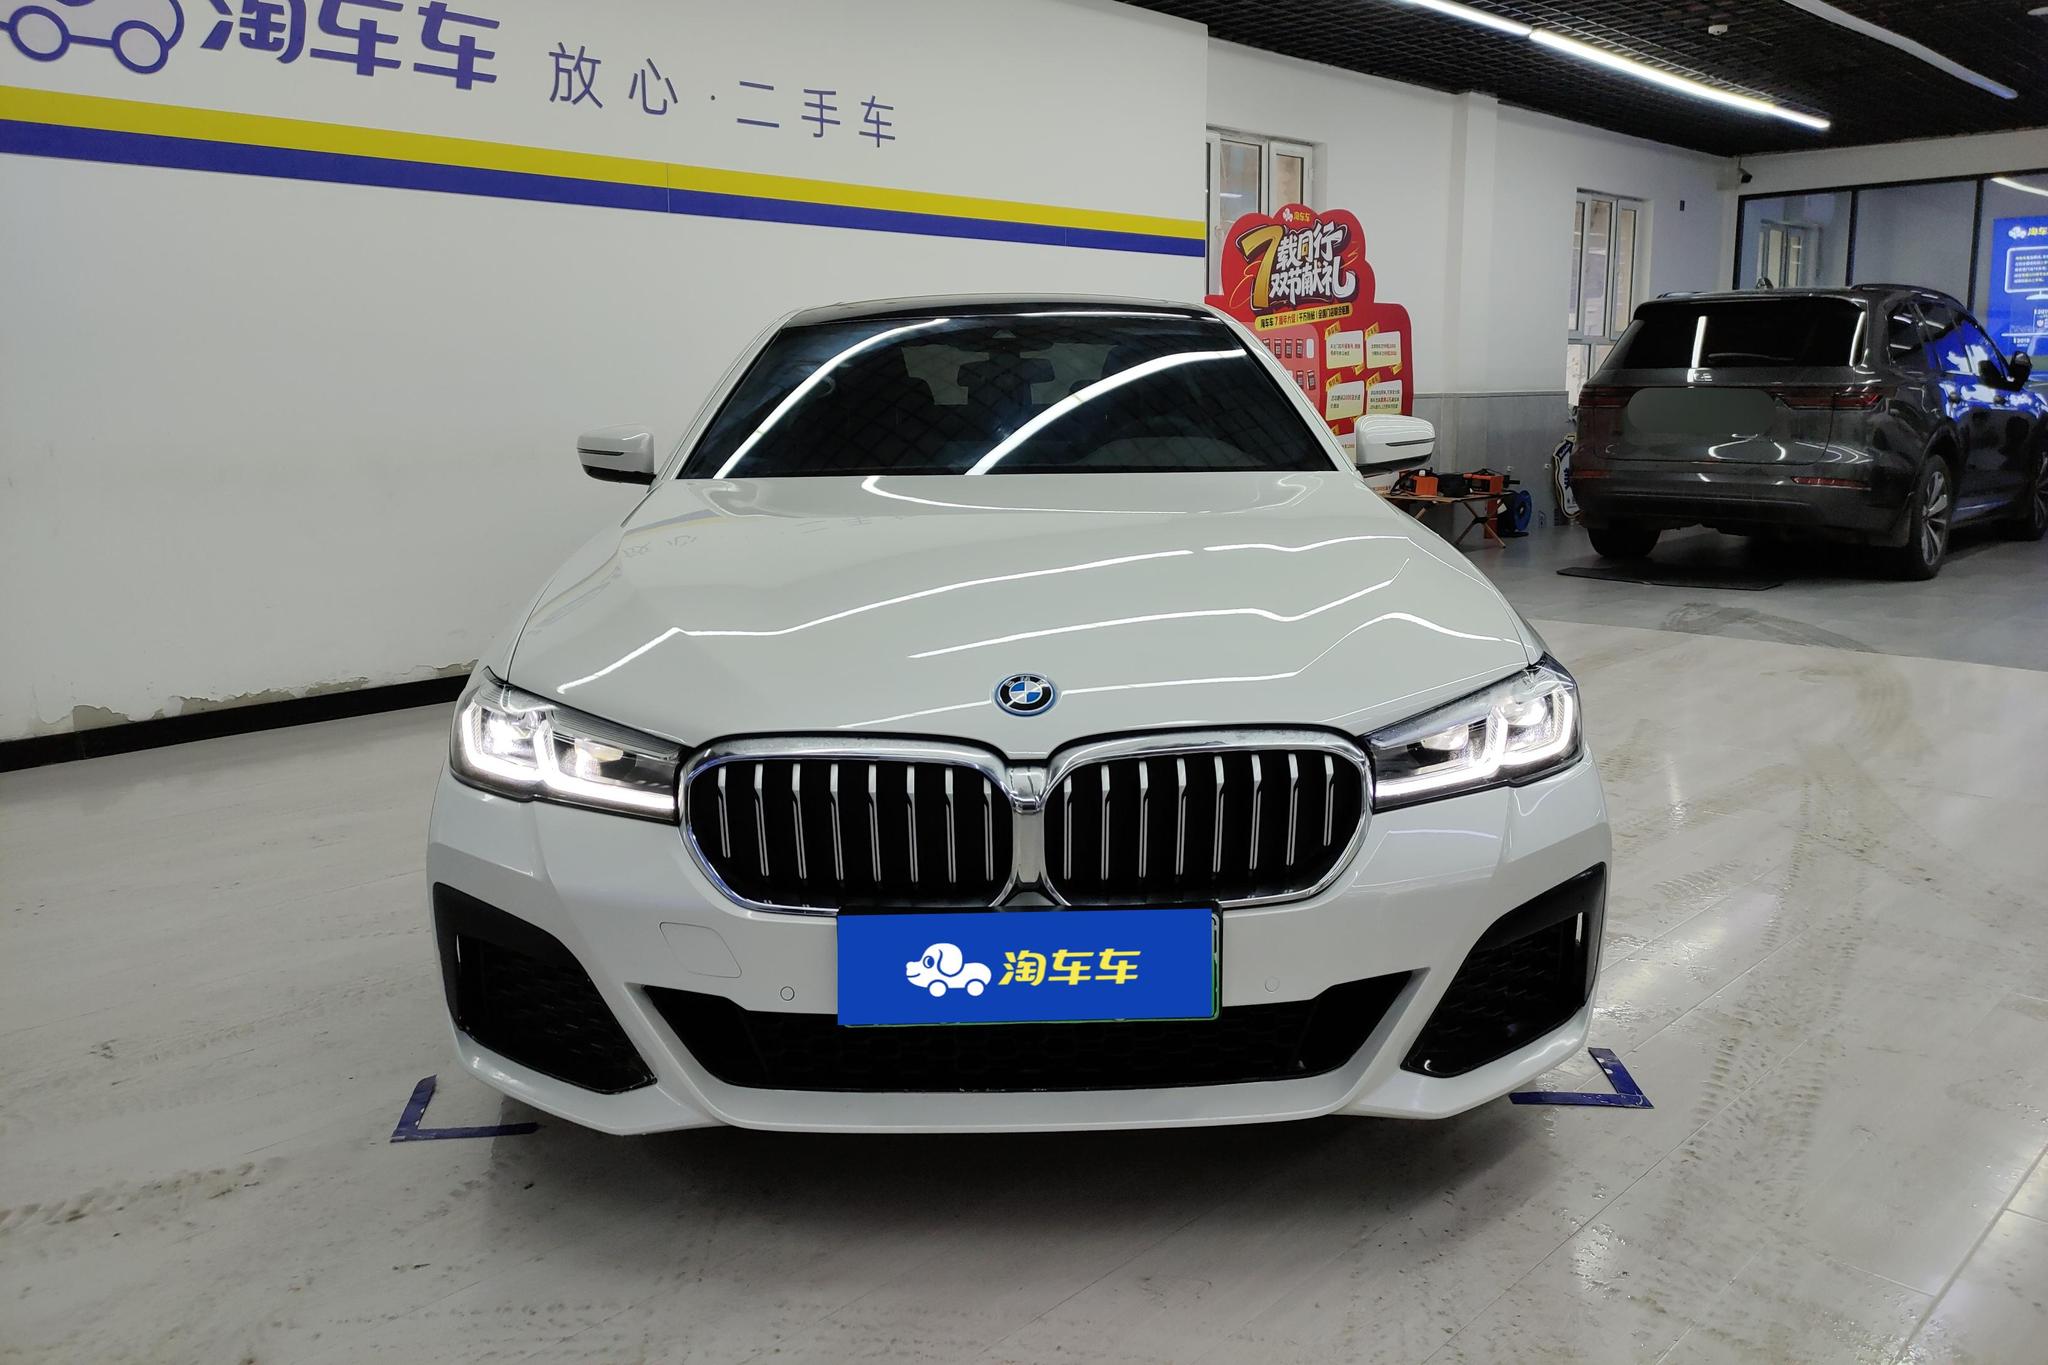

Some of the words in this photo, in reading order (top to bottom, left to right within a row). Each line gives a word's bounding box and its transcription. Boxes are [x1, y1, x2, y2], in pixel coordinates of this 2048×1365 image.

[200, 0, 500, 91] 淘车车
[1269, 256, 1356, 305] 双节献礼
